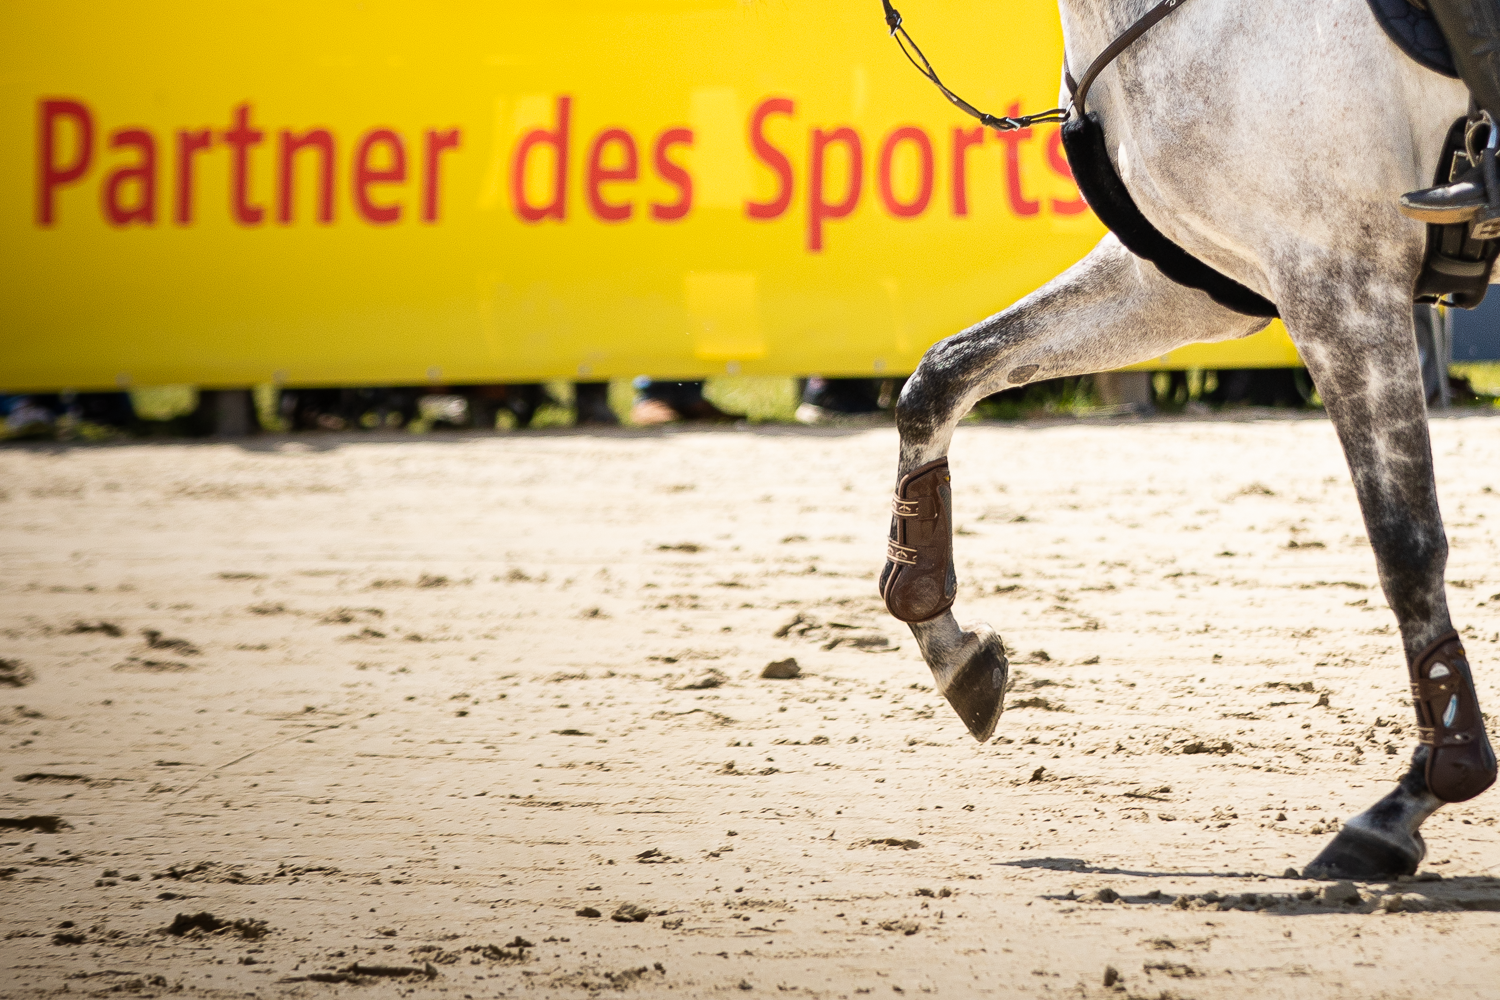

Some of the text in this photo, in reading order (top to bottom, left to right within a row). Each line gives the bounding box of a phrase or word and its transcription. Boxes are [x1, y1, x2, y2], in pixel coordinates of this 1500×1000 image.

[35, 95, 1088, 252] Partner des Sports
